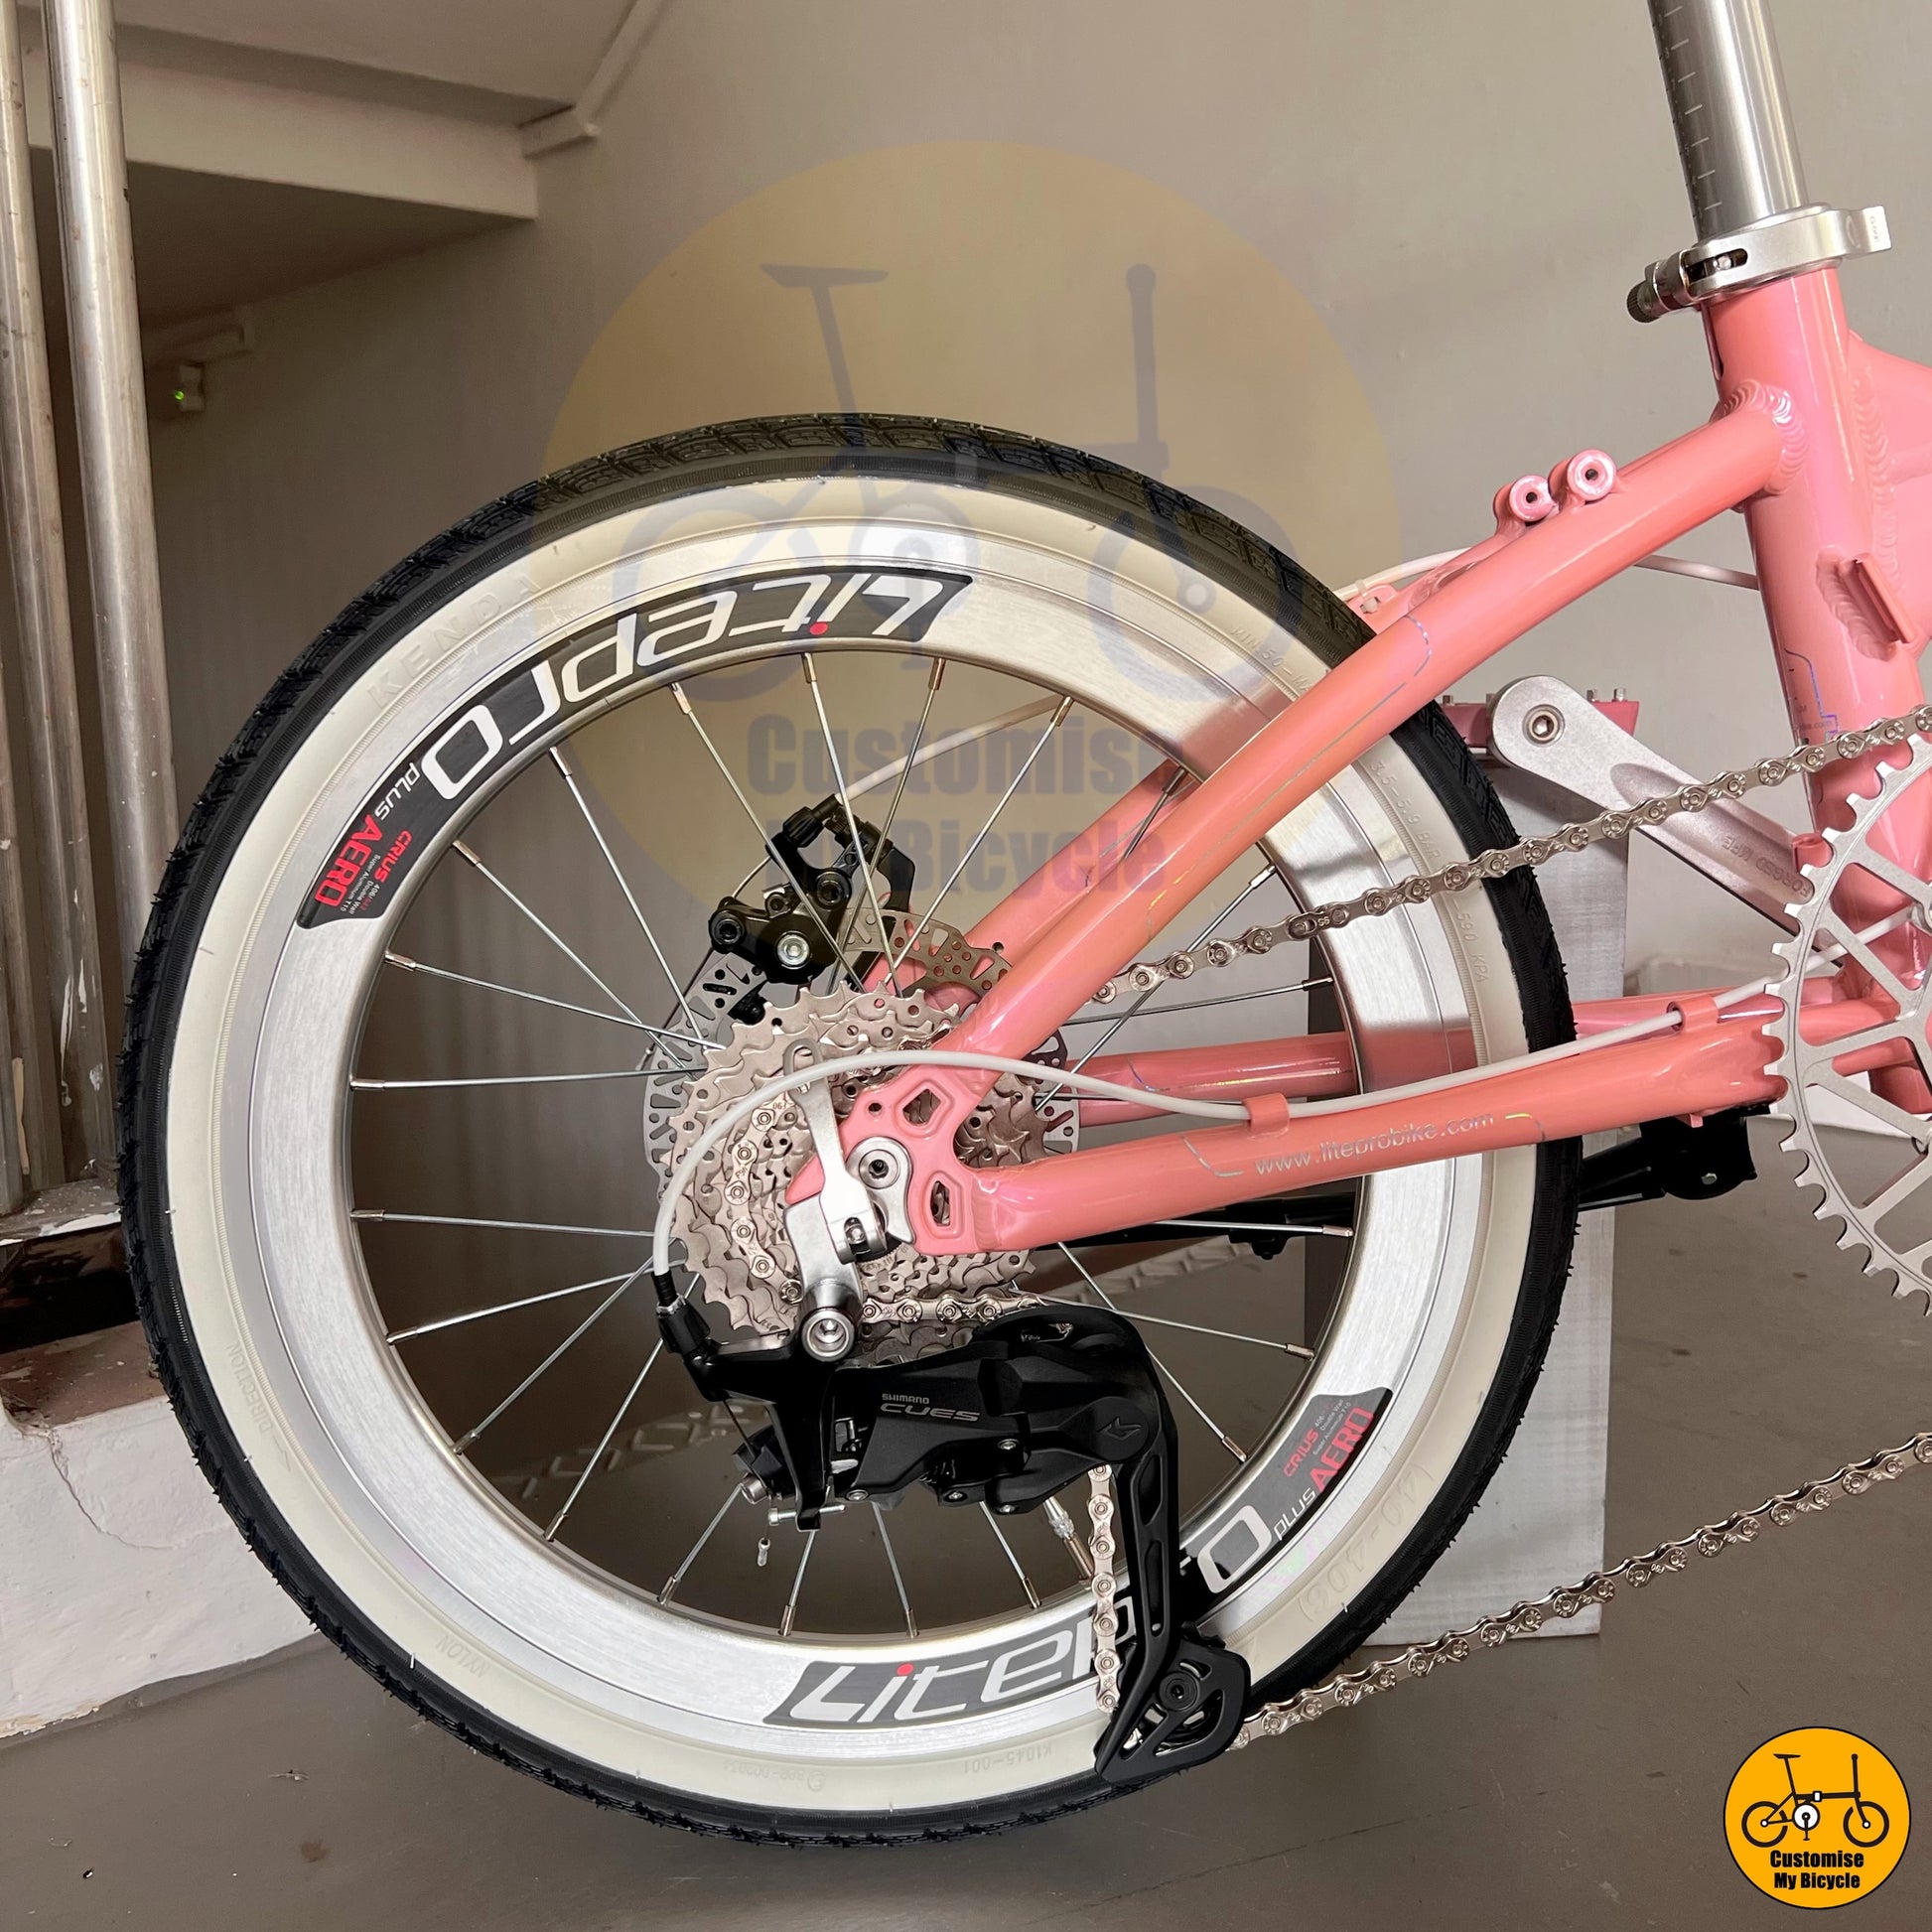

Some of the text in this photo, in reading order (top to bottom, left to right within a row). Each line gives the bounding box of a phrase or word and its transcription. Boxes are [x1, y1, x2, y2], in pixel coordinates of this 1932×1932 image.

[368, 573, 541, 708] KENDA
[314, 814, 383, 906] AERO
[373, 830, 413, 883] CRIUS
[1470, 952, 1490, 984] KPA
[224, 1342, 273, 1436] DIRECTION
[880, 1403, 981, 1423] CUES
[882, 1393, 930, 1406] SHIMANO
[1284, 1429, 1319, 1477] CRIUS
[1310, 1406, 1375, 1492] AERO
[437, 1635, 490, 1678] NYLON
[962, 1741, 1053, 1774] K1045-001
